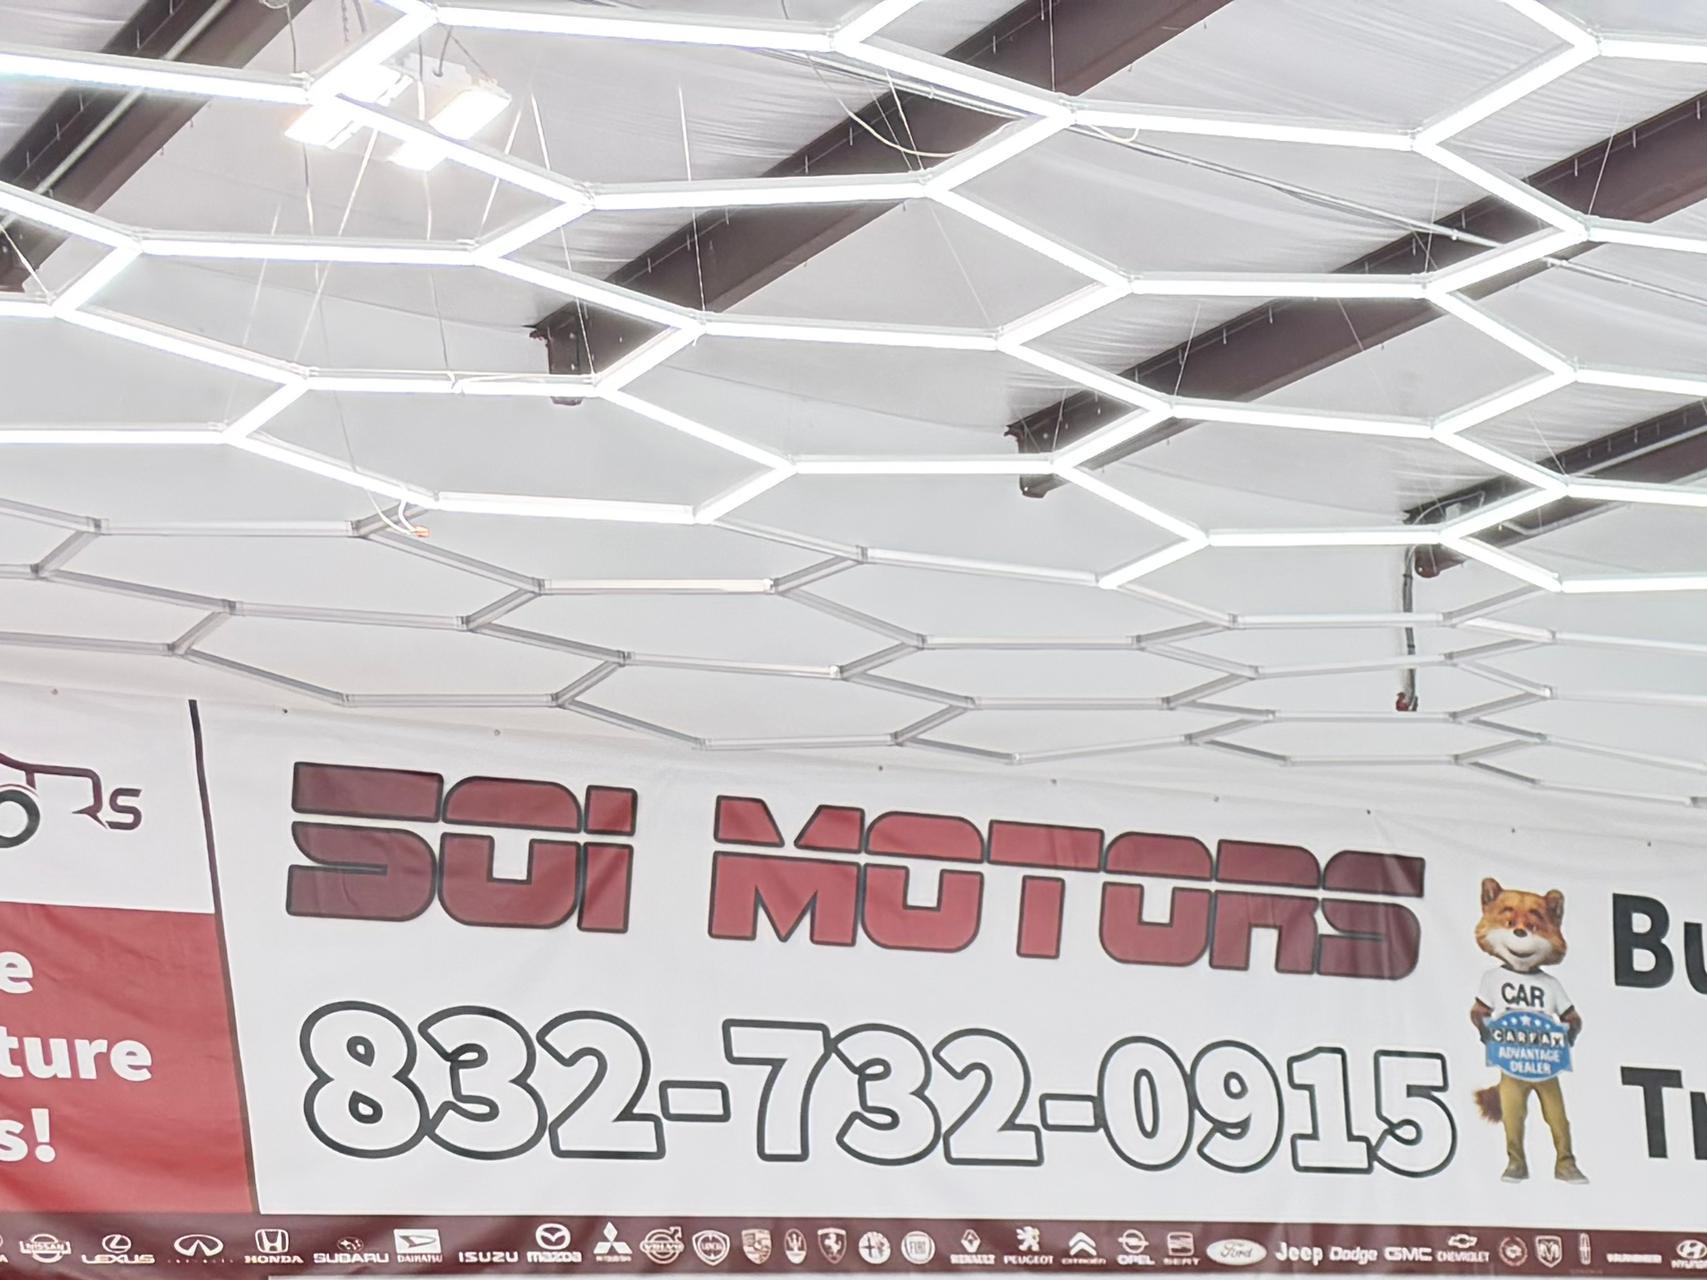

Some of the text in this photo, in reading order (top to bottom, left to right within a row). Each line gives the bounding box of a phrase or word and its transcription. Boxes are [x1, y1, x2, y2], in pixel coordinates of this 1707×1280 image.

[708, 795, 1425, 981] MOTORS
[1501, 982, 1545, 1008] CAR
[1499, 1046, 1560, 1062] ADVANTAGE
[1510, 1061, 1552, 1075] DEALER
[300, 1000, 1457, 1178] 832-732-0915
[82, 1254, 155, 1264] LEXUS
[244, 1255, 304, 1264] HONDA
[313, 1252, 390, 1263] SUBARU
[459, 1251, 519, 1263] ISUZU
[1003, 1254, 1054, 1265] PEUGEOT
[1117, 1255, 1155, 1266] OPEL
[1275, 1242, 1323, 1266] Jeep
[1329, 1246, 1378, 1265] Dodge
[1384, 1246, 1433, 1262] GMC
[1436, 1251, 1490, 1263] CHEVROLET
